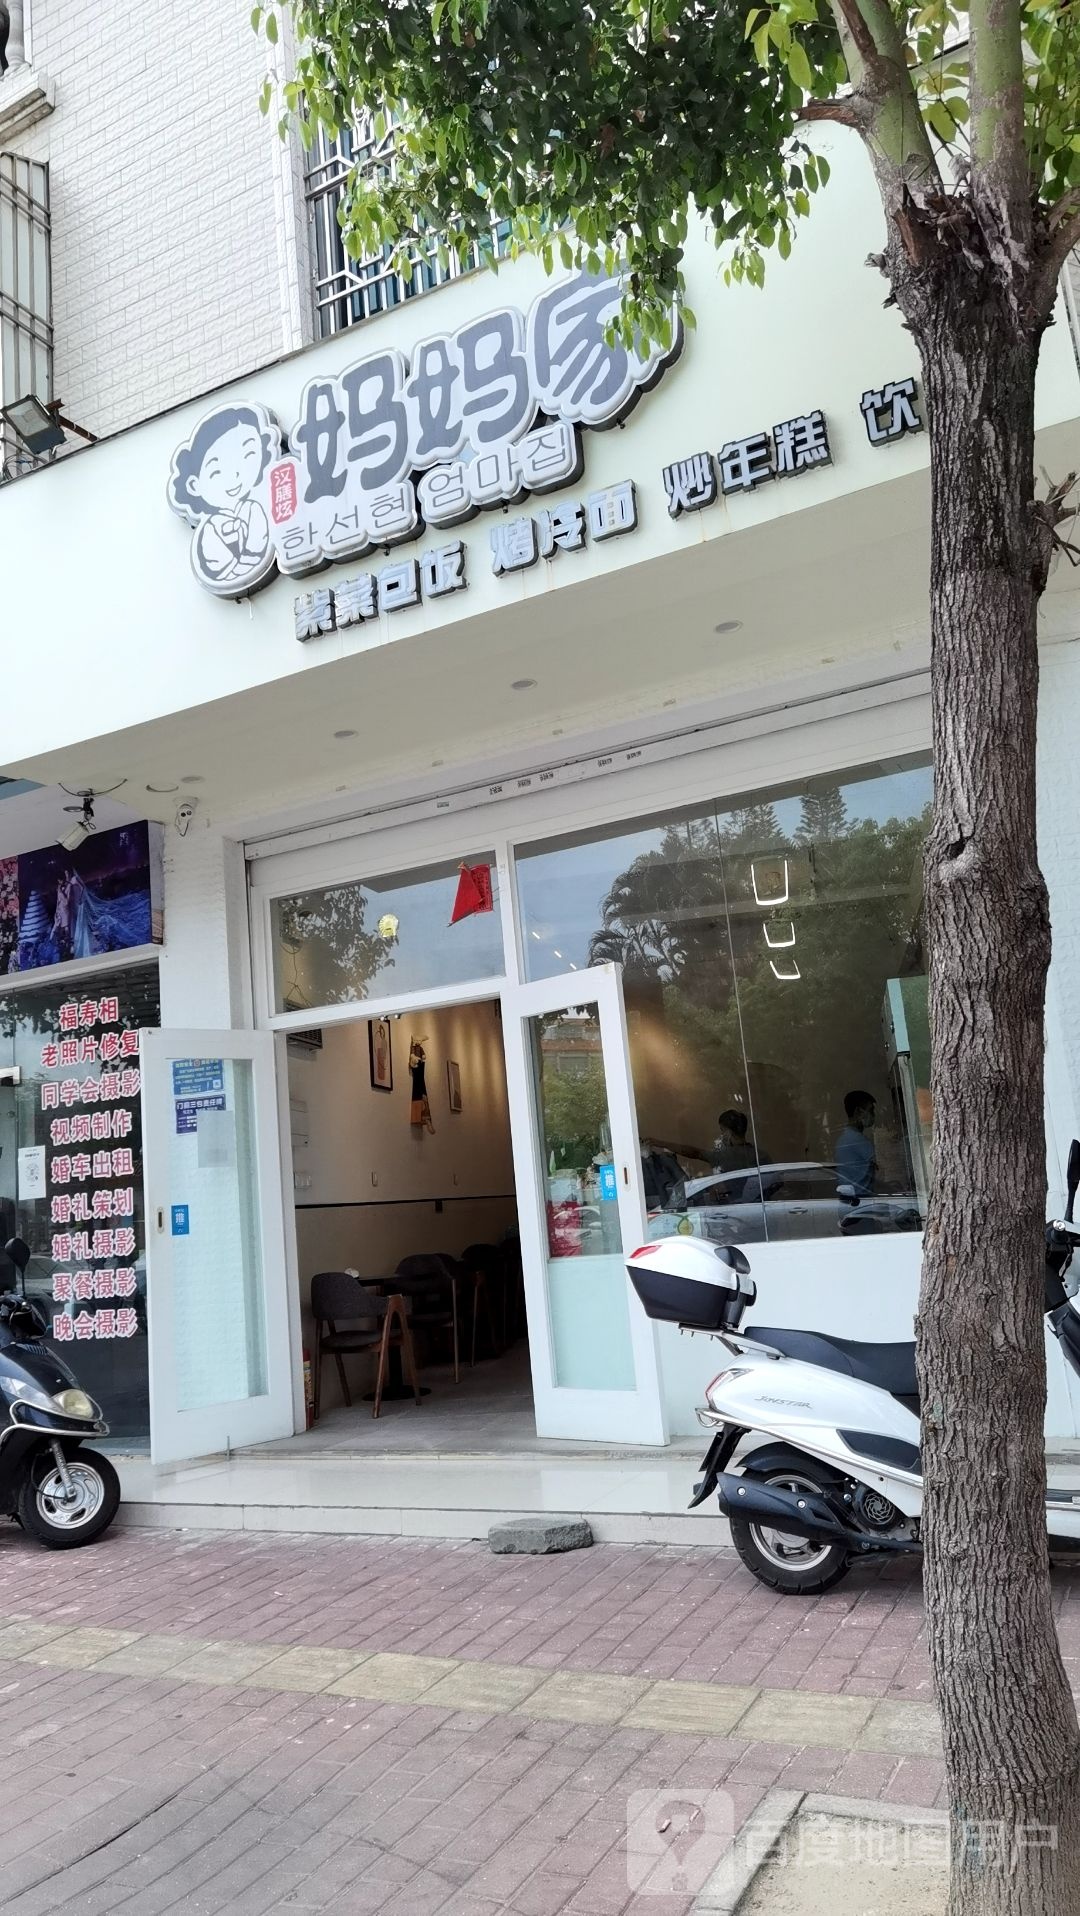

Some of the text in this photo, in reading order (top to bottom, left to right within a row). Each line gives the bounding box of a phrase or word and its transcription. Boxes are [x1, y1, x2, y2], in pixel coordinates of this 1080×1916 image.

[292, 255, 672, 502] 妈妈家
[281, 427, 566, 560] 한선현 엄마집
[294, 541, 468, 642] 紫菜包饭
[662, 410, 834, 520] 炒年糕
[860, 377, 923, 448] 饮
[60, 997, 119, 1031] 福寿相
[41, 1030, 139, 1069] 老照片修复
[41, 1070, 140, 1110] 同学会摄影
[51, 1109, 132, 1146] 视频制作
[51, 1148, 134, 1184] 婚车出租
[51, 1188, 134, 1224] 婚礼策划
[51, 1227, 136, 1262] 婚礼摄影
[53, 1267, 137, 1301] 聚餐摄影
[53, 1308, 138, 1342] 晚会摄影
